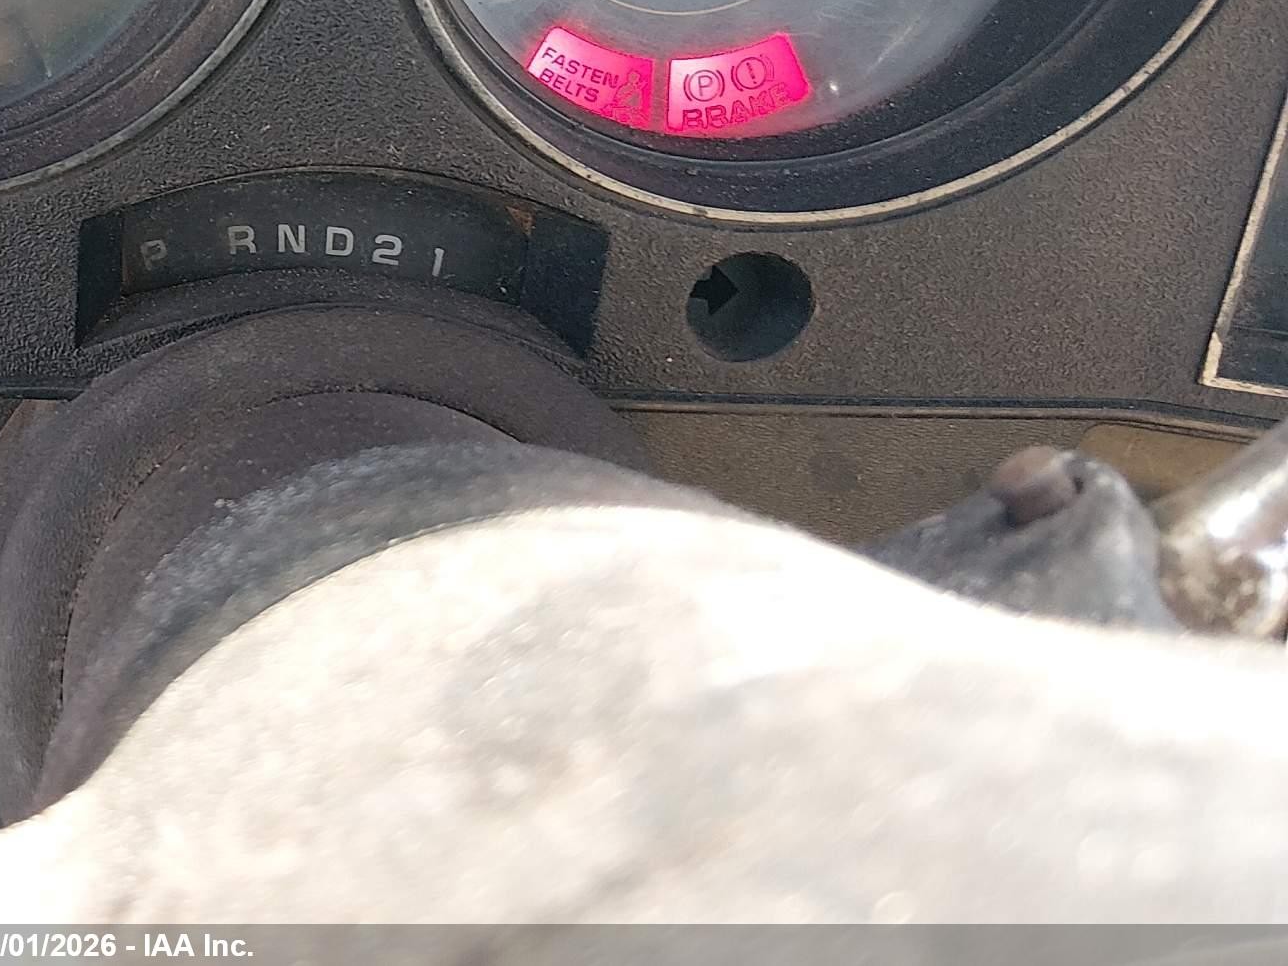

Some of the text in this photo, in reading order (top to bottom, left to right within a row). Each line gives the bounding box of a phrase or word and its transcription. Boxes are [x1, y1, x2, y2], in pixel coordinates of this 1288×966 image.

[538, 68, 600, 103] BELTS
[541, 46, 620, 89] FASTEN
[682, 82, 792, 129] BRAKE
